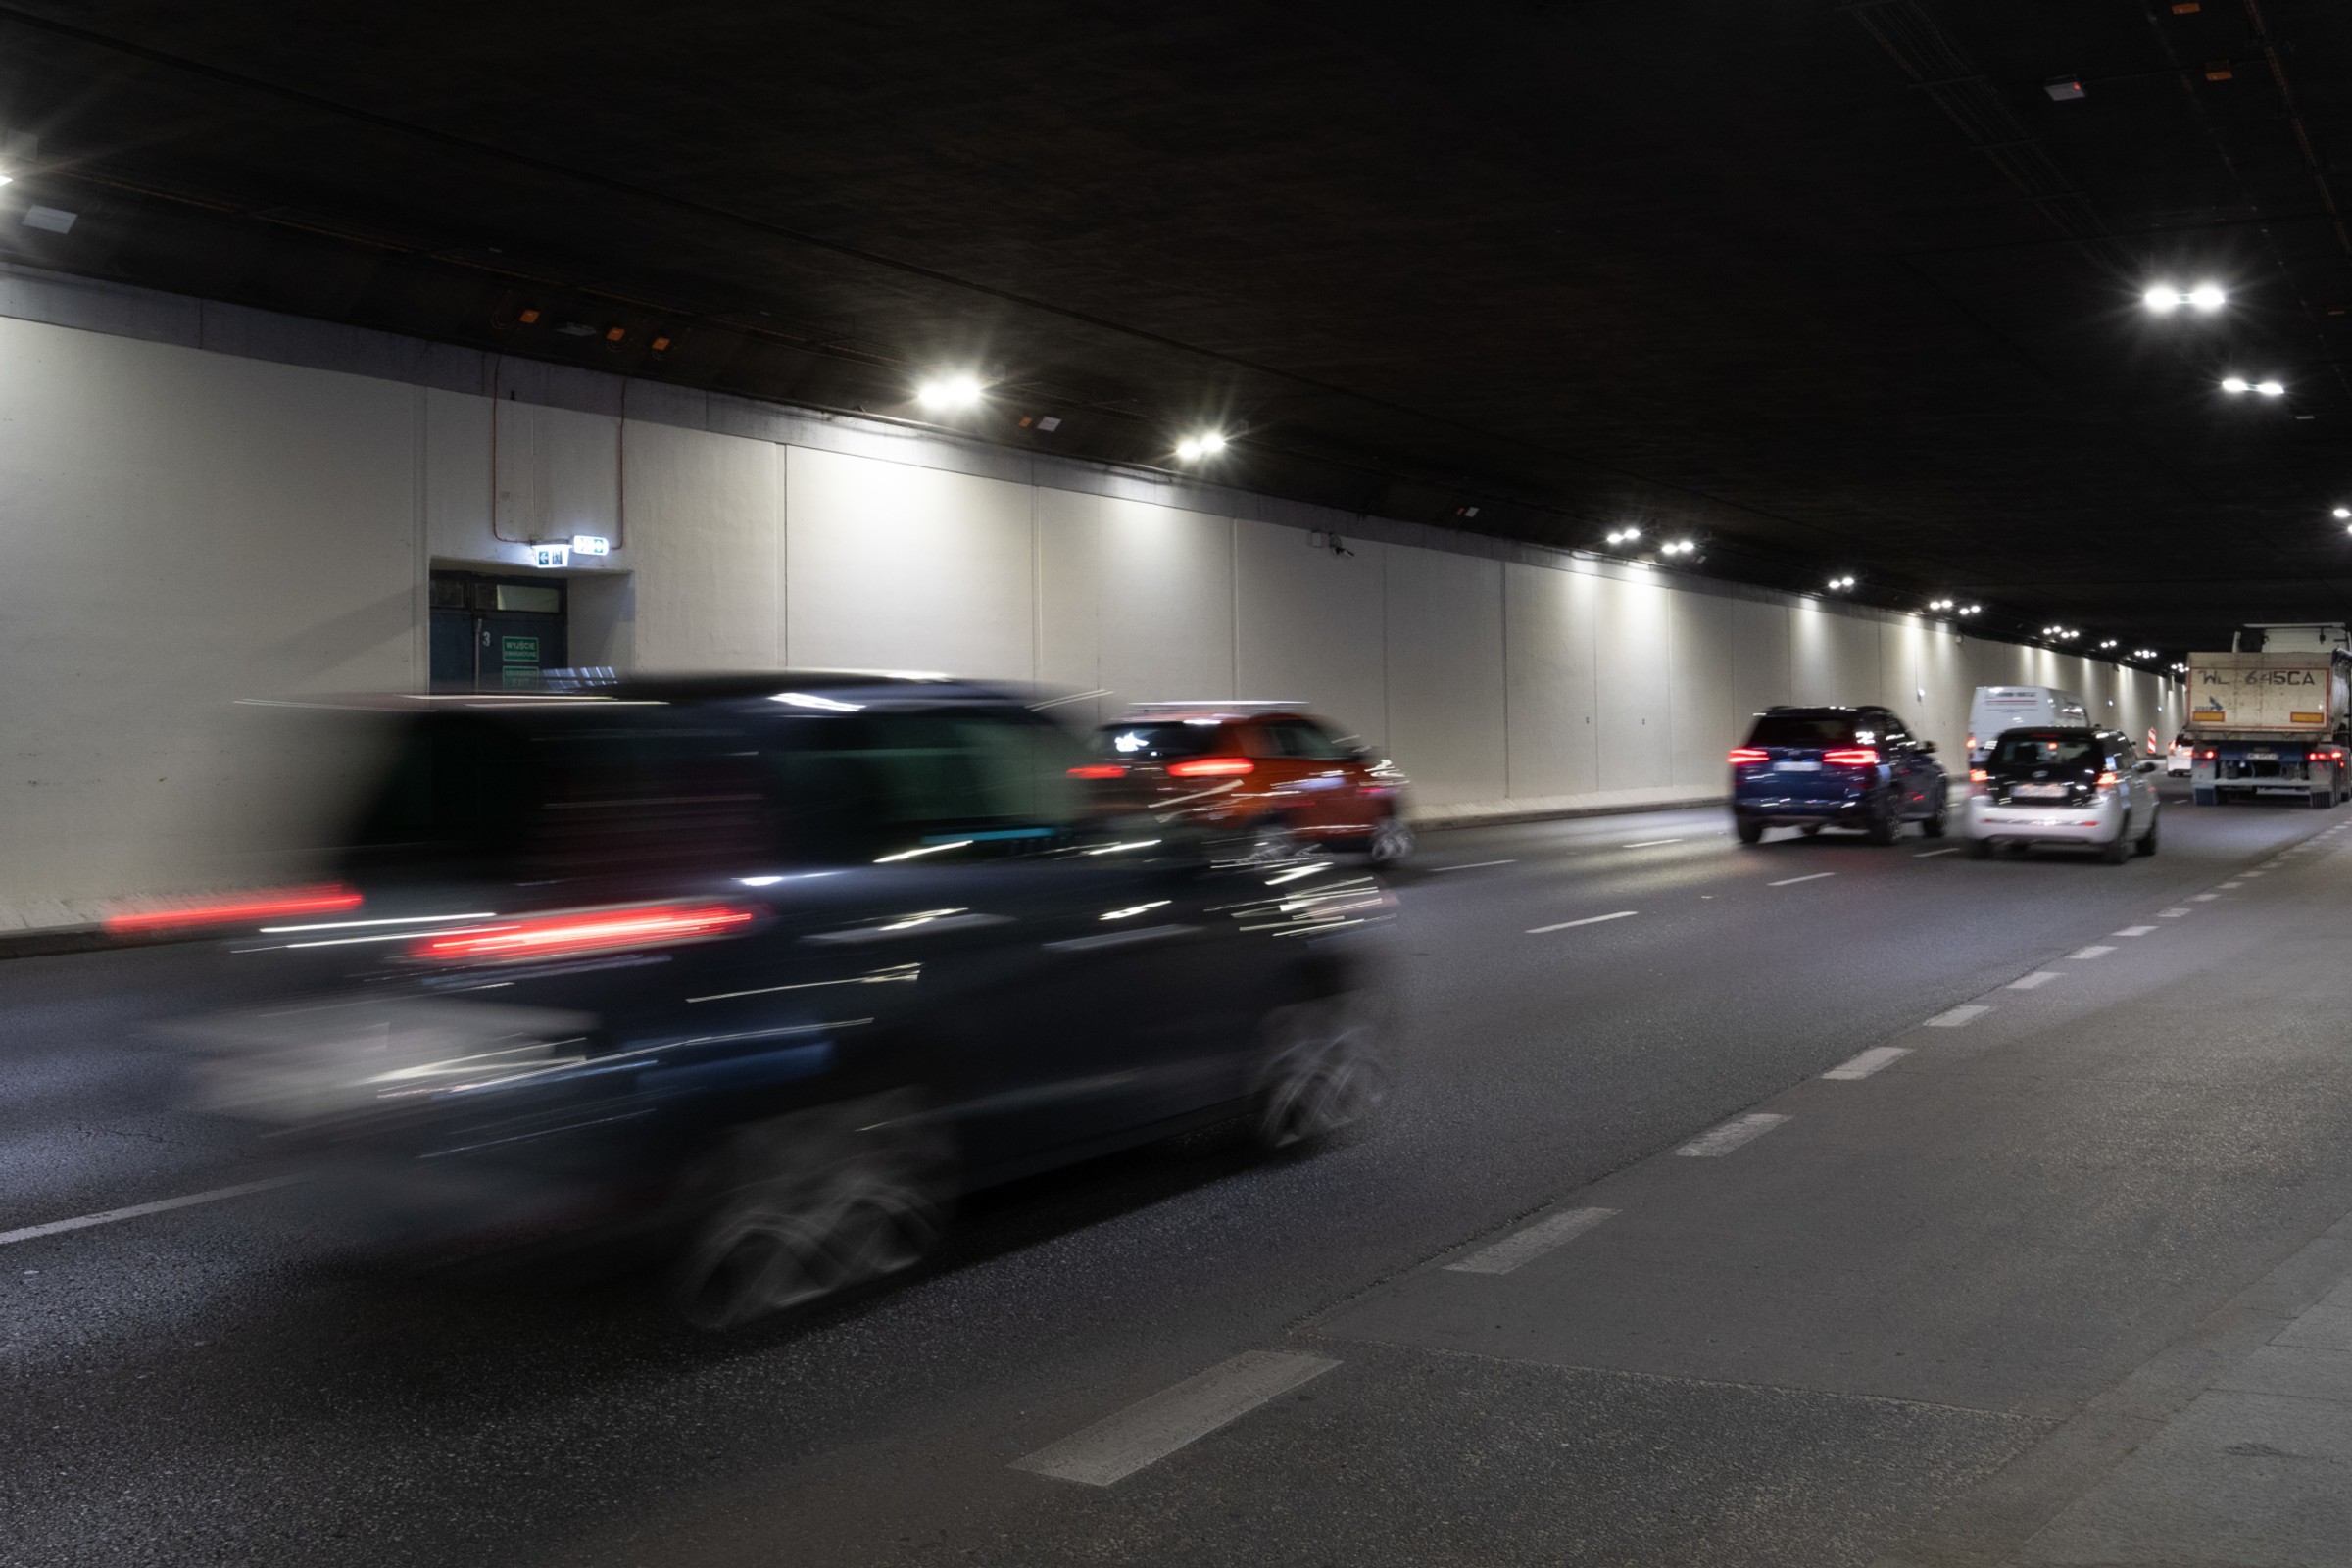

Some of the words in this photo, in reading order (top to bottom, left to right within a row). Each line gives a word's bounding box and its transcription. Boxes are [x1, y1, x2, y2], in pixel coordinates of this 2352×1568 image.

[482, 631, 491, 647] 3
[506, 640, 536, 651] WYJŚCIE
[2197, 670, 2230, 685] WL
[2245, 670, 2316, 686] 645CA
